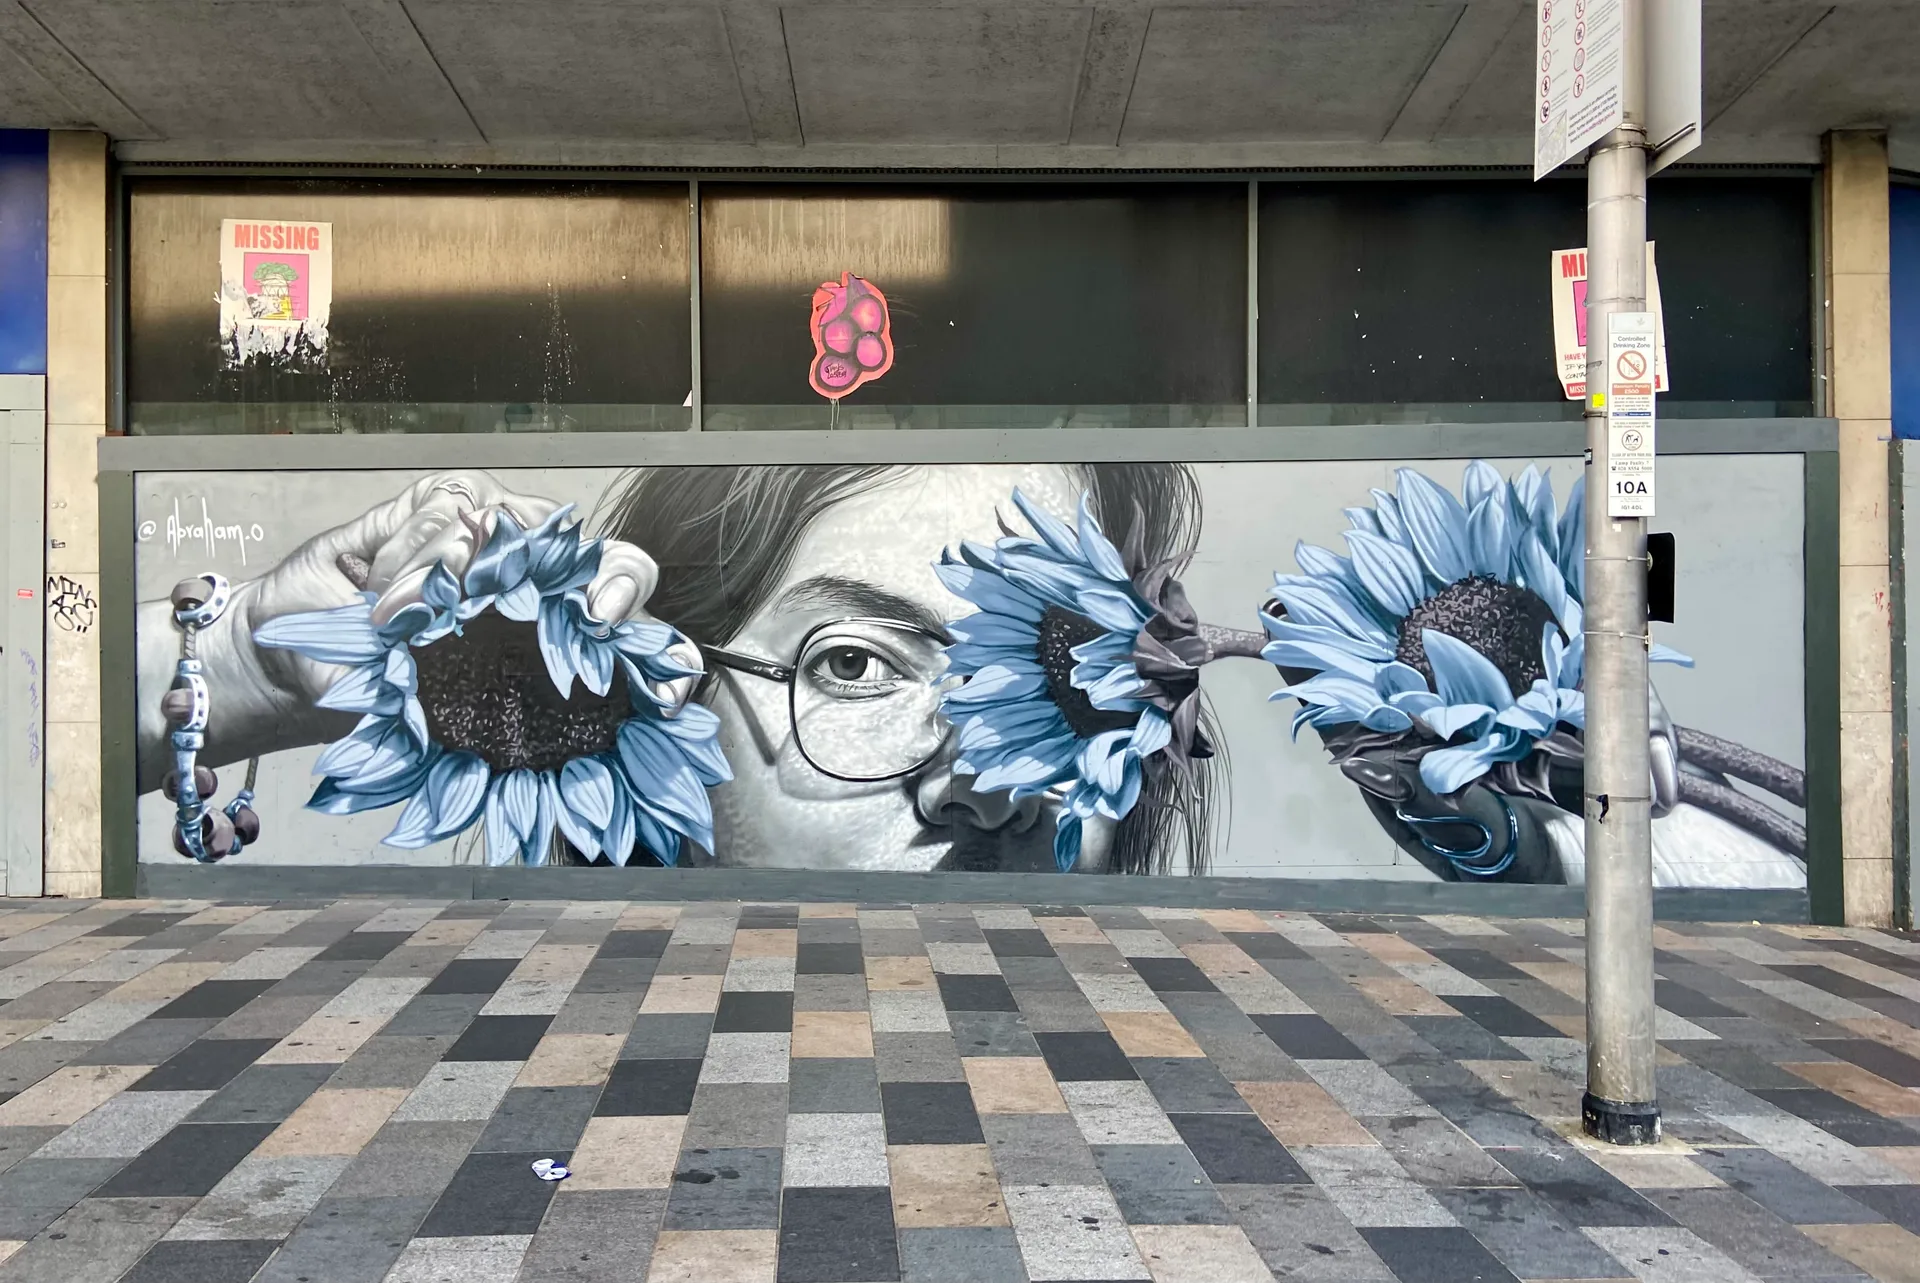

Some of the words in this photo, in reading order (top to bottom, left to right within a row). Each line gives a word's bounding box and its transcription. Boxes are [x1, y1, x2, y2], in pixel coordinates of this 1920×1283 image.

[234, 224, 320, 250] MISSING
[1561, 253, 1587, 278] MI
[1564, 352, 1580, 360] HAVE
[1565, 372, 1587, 380] CONTA
[1616, 481, 1647, 494] 10A
